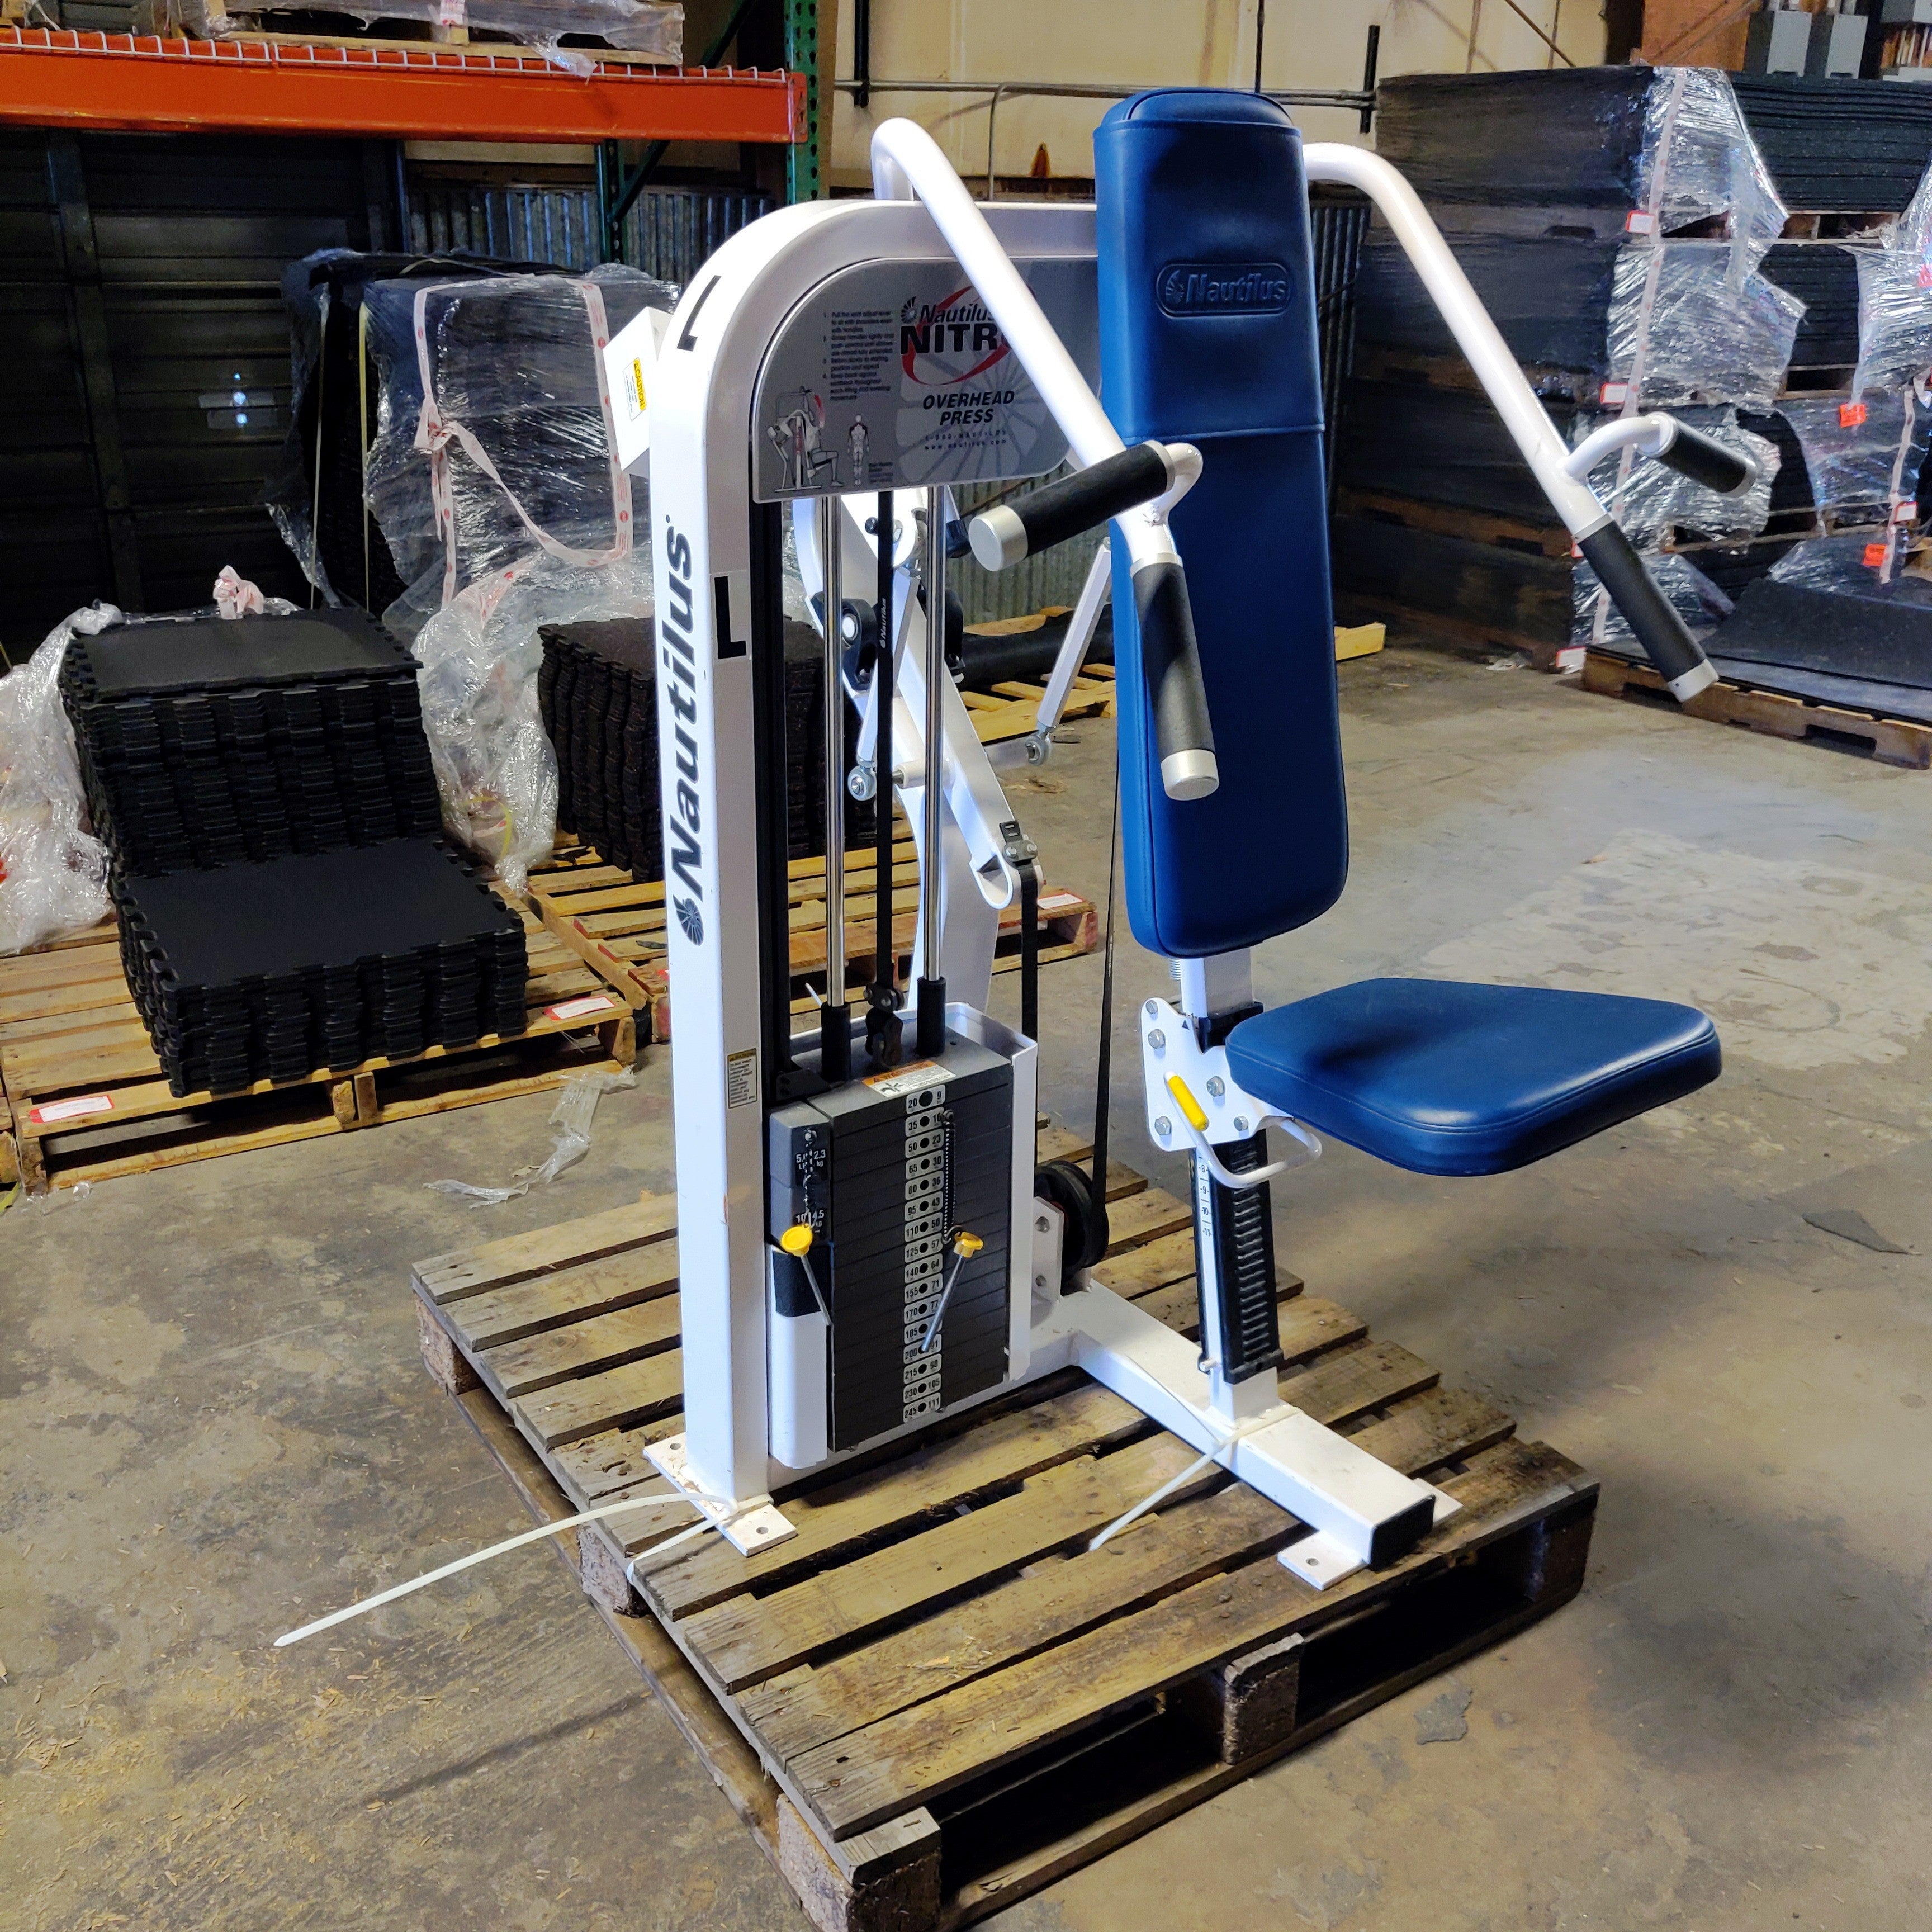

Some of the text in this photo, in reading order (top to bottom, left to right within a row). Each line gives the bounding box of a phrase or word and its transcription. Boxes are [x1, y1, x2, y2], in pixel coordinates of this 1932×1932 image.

[1186, 273, 1286, 303] Nautilus
[901, 323, 1006, 354] NITR
[635, 369, 645, 407] CAUTION
[923, 390, 1015, 409] OVERHEAD
[940, 409, 994, 425] PRESS
[662, 525, 703, 902] Nautilus
[908, 1091, 941, 1108] 20 9
[908, 1121, 917, 1130] 35
[908, 1134, 941, 1152] 50 23
[814, 1149, 826, 1159] 2.3
[909, 1156, 941, 1173] 65 30
[932, 1176, 941, 1186] 36
[908, 1197, 940, 1215] 95 43
[907, 1218, 940, 1237] 110 50
[1205, 1228, 1210, 1237] 11
[907, 1239, 939, 1258] 125 57
[907, 1259, 939, 1278] 140 64
[906, 1287, 918, 1298] 155
[906, 1300, 939, 1319] 170 77
[905, 1348, 917, 1360] 200
[905, 1368, 917, 1379] 215
[905, 1378, 940, 1399] 230 105
[905, 1397, 939, 1418] 245 111
